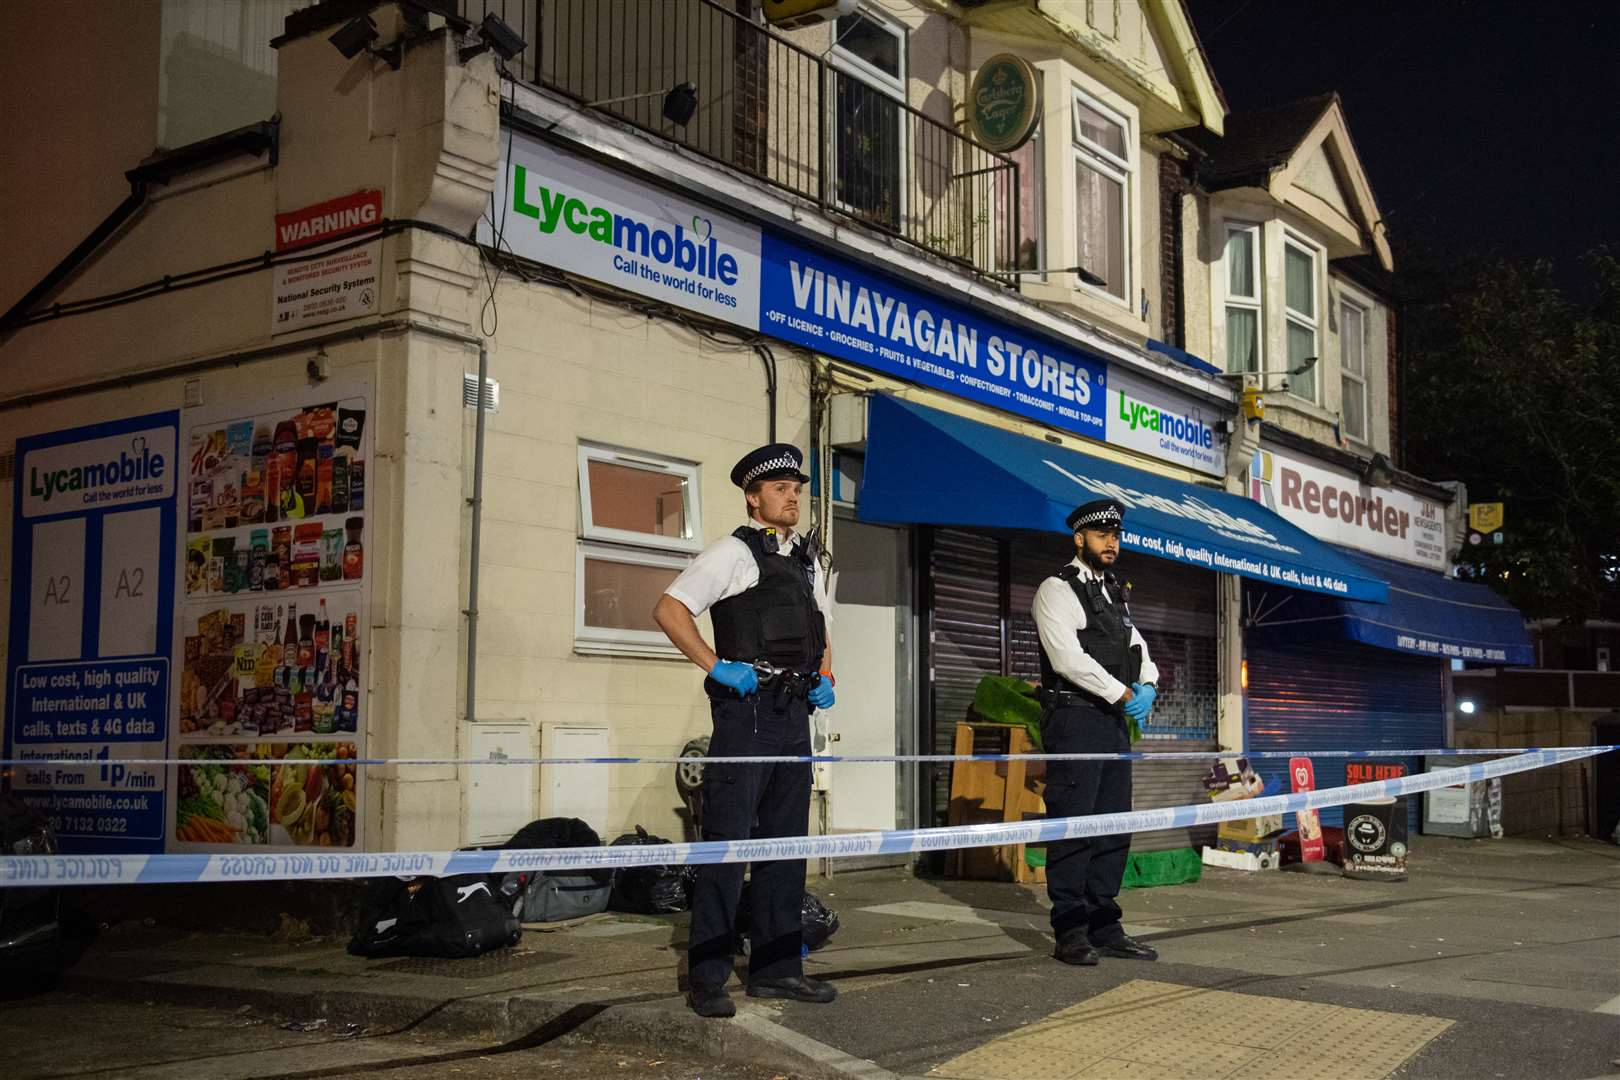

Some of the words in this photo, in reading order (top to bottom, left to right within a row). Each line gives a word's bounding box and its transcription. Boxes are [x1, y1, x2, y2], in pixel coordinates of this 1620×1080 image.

[280, 203, 376, 243] WARNING
[513, 164, 738, 286] Lycamobile
[277, 289, 308, 304] National
[310, 283, 341, 298] Security
[343, 276, 375, 291] Systems
[613, 255, 638, 275] Call
[640, 264, 660, 283] the
[662, 273, 695, 294] world
[697, 283, 714, 299] for
[715, 288, 737, 308] less
[790, 260, 977, 368] VINAYAGAN
[986, 336, 1091, 405] STORES
[769, 310, 786, 324] OFF
[788, 314, 823, 337] LICENCE
[830, 330, 874, 353] GROCERIES
[880, 347, 905, 364] FRUITS
[906, 355, 911, 366] &
[912, 357, 955, 380] VEGETABLES
[959, 373, 1012, 398] CONFECTIONERY
[1015, 391, 1055, 412] TOBACCONIST
[1059, 405, 1079, 420] MOBILE
[1080, 412, 1104, 427] TOP-UPS
[1119, 390, 1212, 449] Lycamobile
[31, 448, 164, 501] Lycamobile
[112, 486, 134, 499] world
[135, 485, 145, 495] for
[147, 483, 163, 494] less
[1281, 466, 1409, 540] Recorder
[1121, 531, 1140, 545] Low
[1142, 536, 1164, 554] cost,
[1166, 539, 1184, 557] high
[1185, 547, 1213, 566] quality
[1214, 551, 1261, 574] International
[1263, 563, 1268, 576] &
[1270, 565, 1281, 579] UK
[1282, 569, 1300, 585] calls,
[1301, 572, 1315, 586] text
[1316, 575, 1322, 588] &
[1333, 579, 1348, 592] data
[44, 575, 71, 606] A2
[115, 568, 144, 599] A2
[23, 673, 47, 689] Low
[50, 671, 80, 690] cost,
[84, 669, 111, 688] high
[115, 667, 160, 688] quality
[32, 693, 110, 712] International
[114, 696, 123, 710] &
[127, 692, 147, 709] UK
[23, 721, 53, 738] calls,
[57, 720, 87, 735] texts
[91, 719, 100, 735] &
[104, 719, 122, 734] 4G
[126, 718, 155, 734] data
[20, 749, 92, 764] International
[26, 769, 52, 784] calls
[55, 770, 85, 785] From
[1347, 764, 1372, 780] SOLD
[1376, 765, 1404, 781] HERE
[65, 817, 94, 832] 7132
[97, 817, 127, 833] 0322
